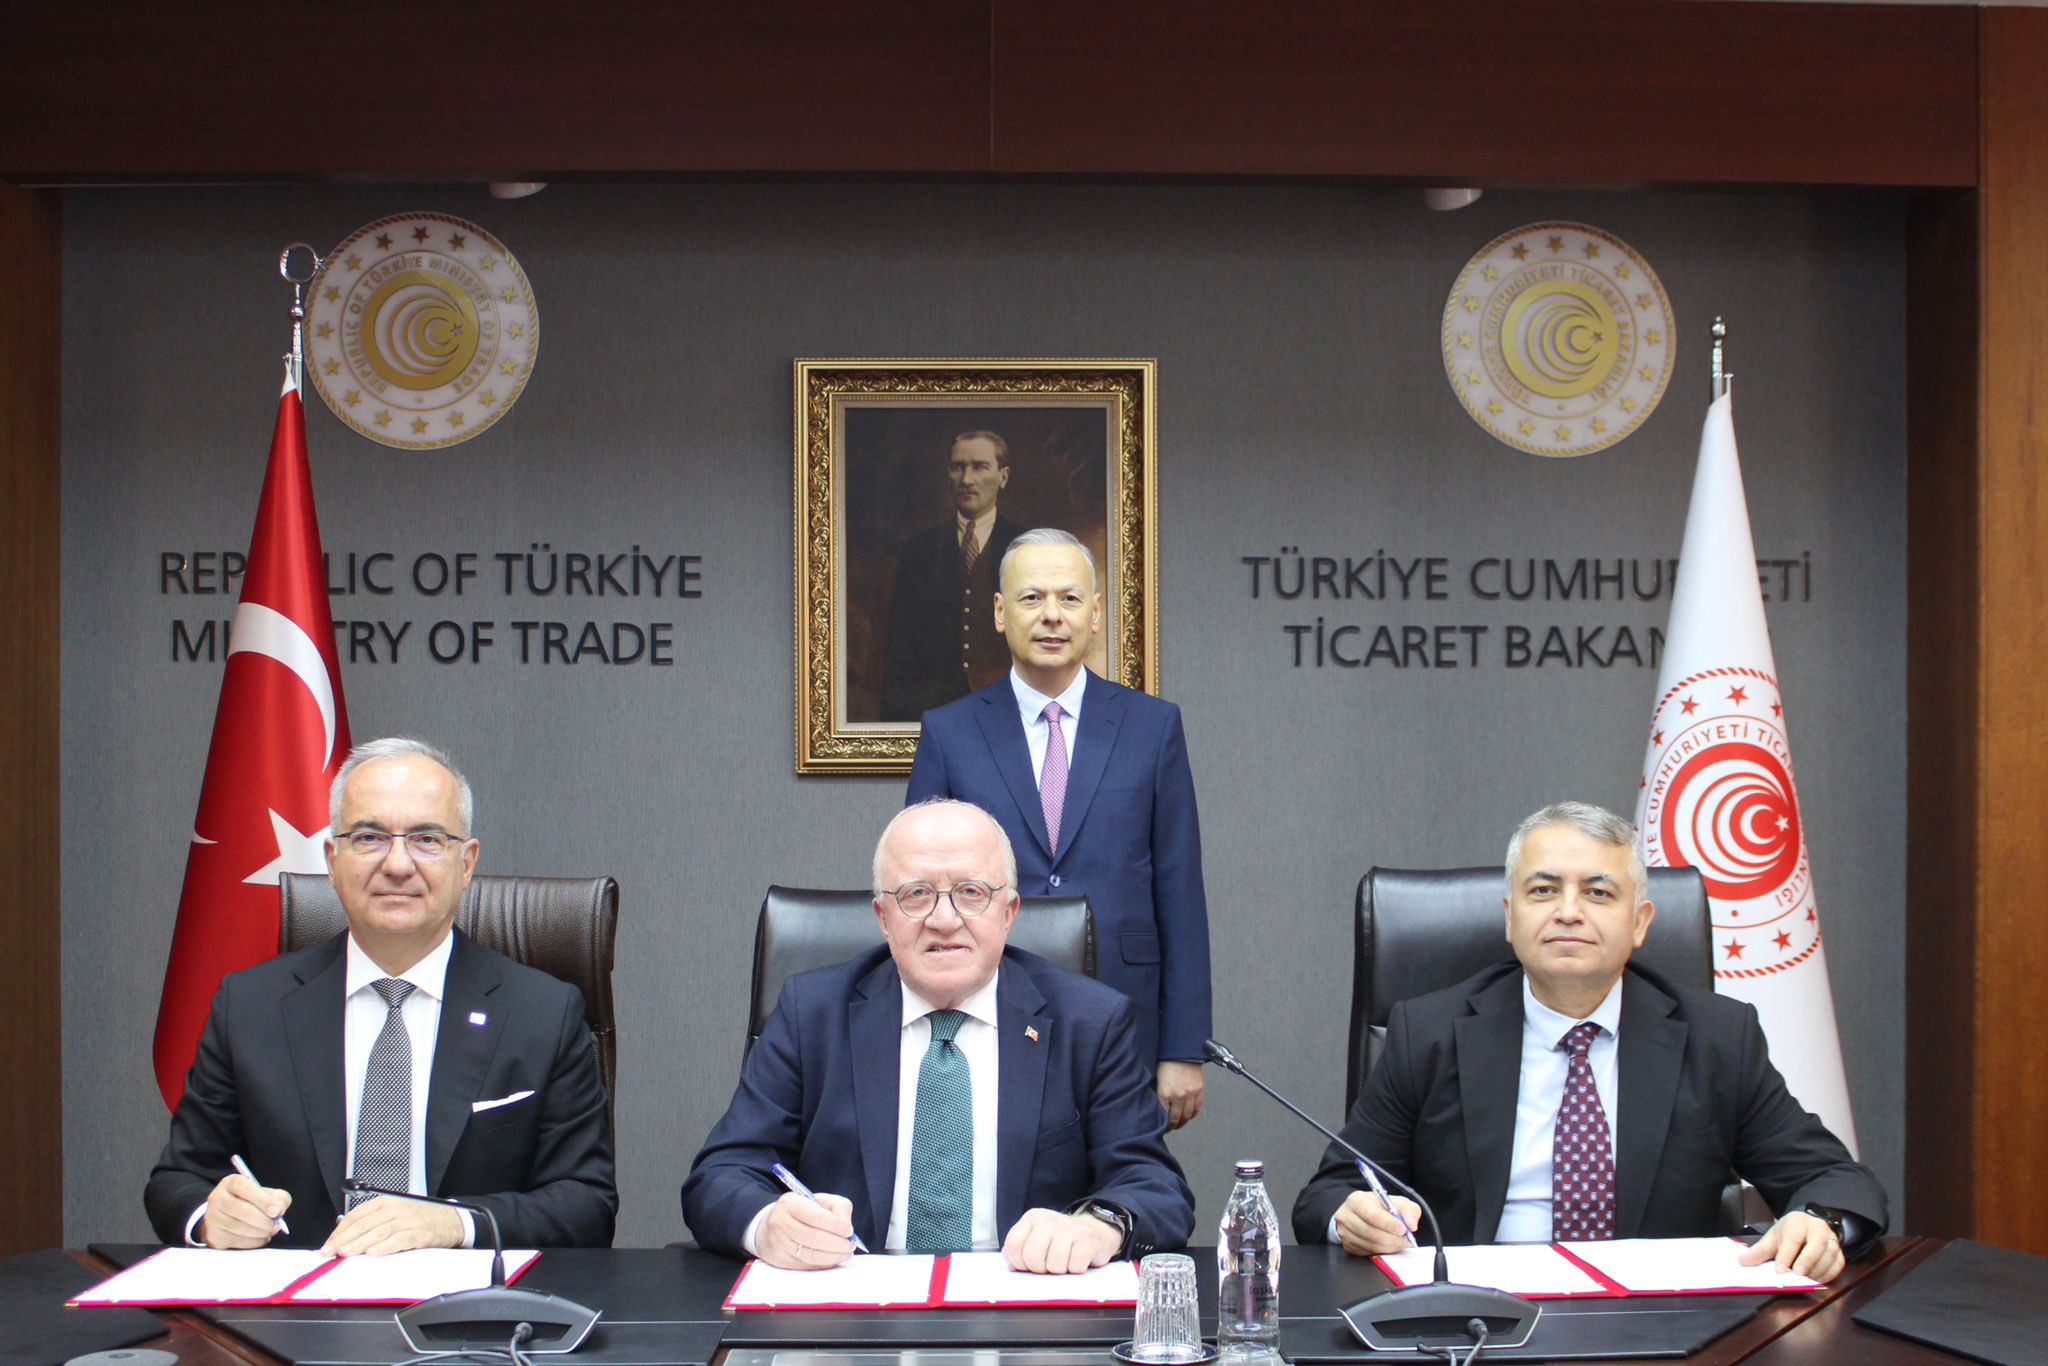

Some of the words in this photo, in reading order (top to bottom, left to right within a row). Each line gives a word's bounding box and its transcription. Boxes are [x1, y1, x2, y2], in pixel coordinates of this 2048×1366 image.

[161, 552, 394, 595] REPLIC
[413, 552, 477, 596] OF
[495, 543, 703, 599] TÜRKİYE
[1242, 546, 1449, 601] TÜRKİYE
[1470, 551, 1811, 602] CUMHUTİ
[172, 619, 411, 664] MIRY
[428, 621, 494, 665] OF
[511, 621, 674, 666] TRADE
[1284, 617, 1488, 668] TİCARET
[1648, 722, 1749, 825] CUMHURİYETİ
